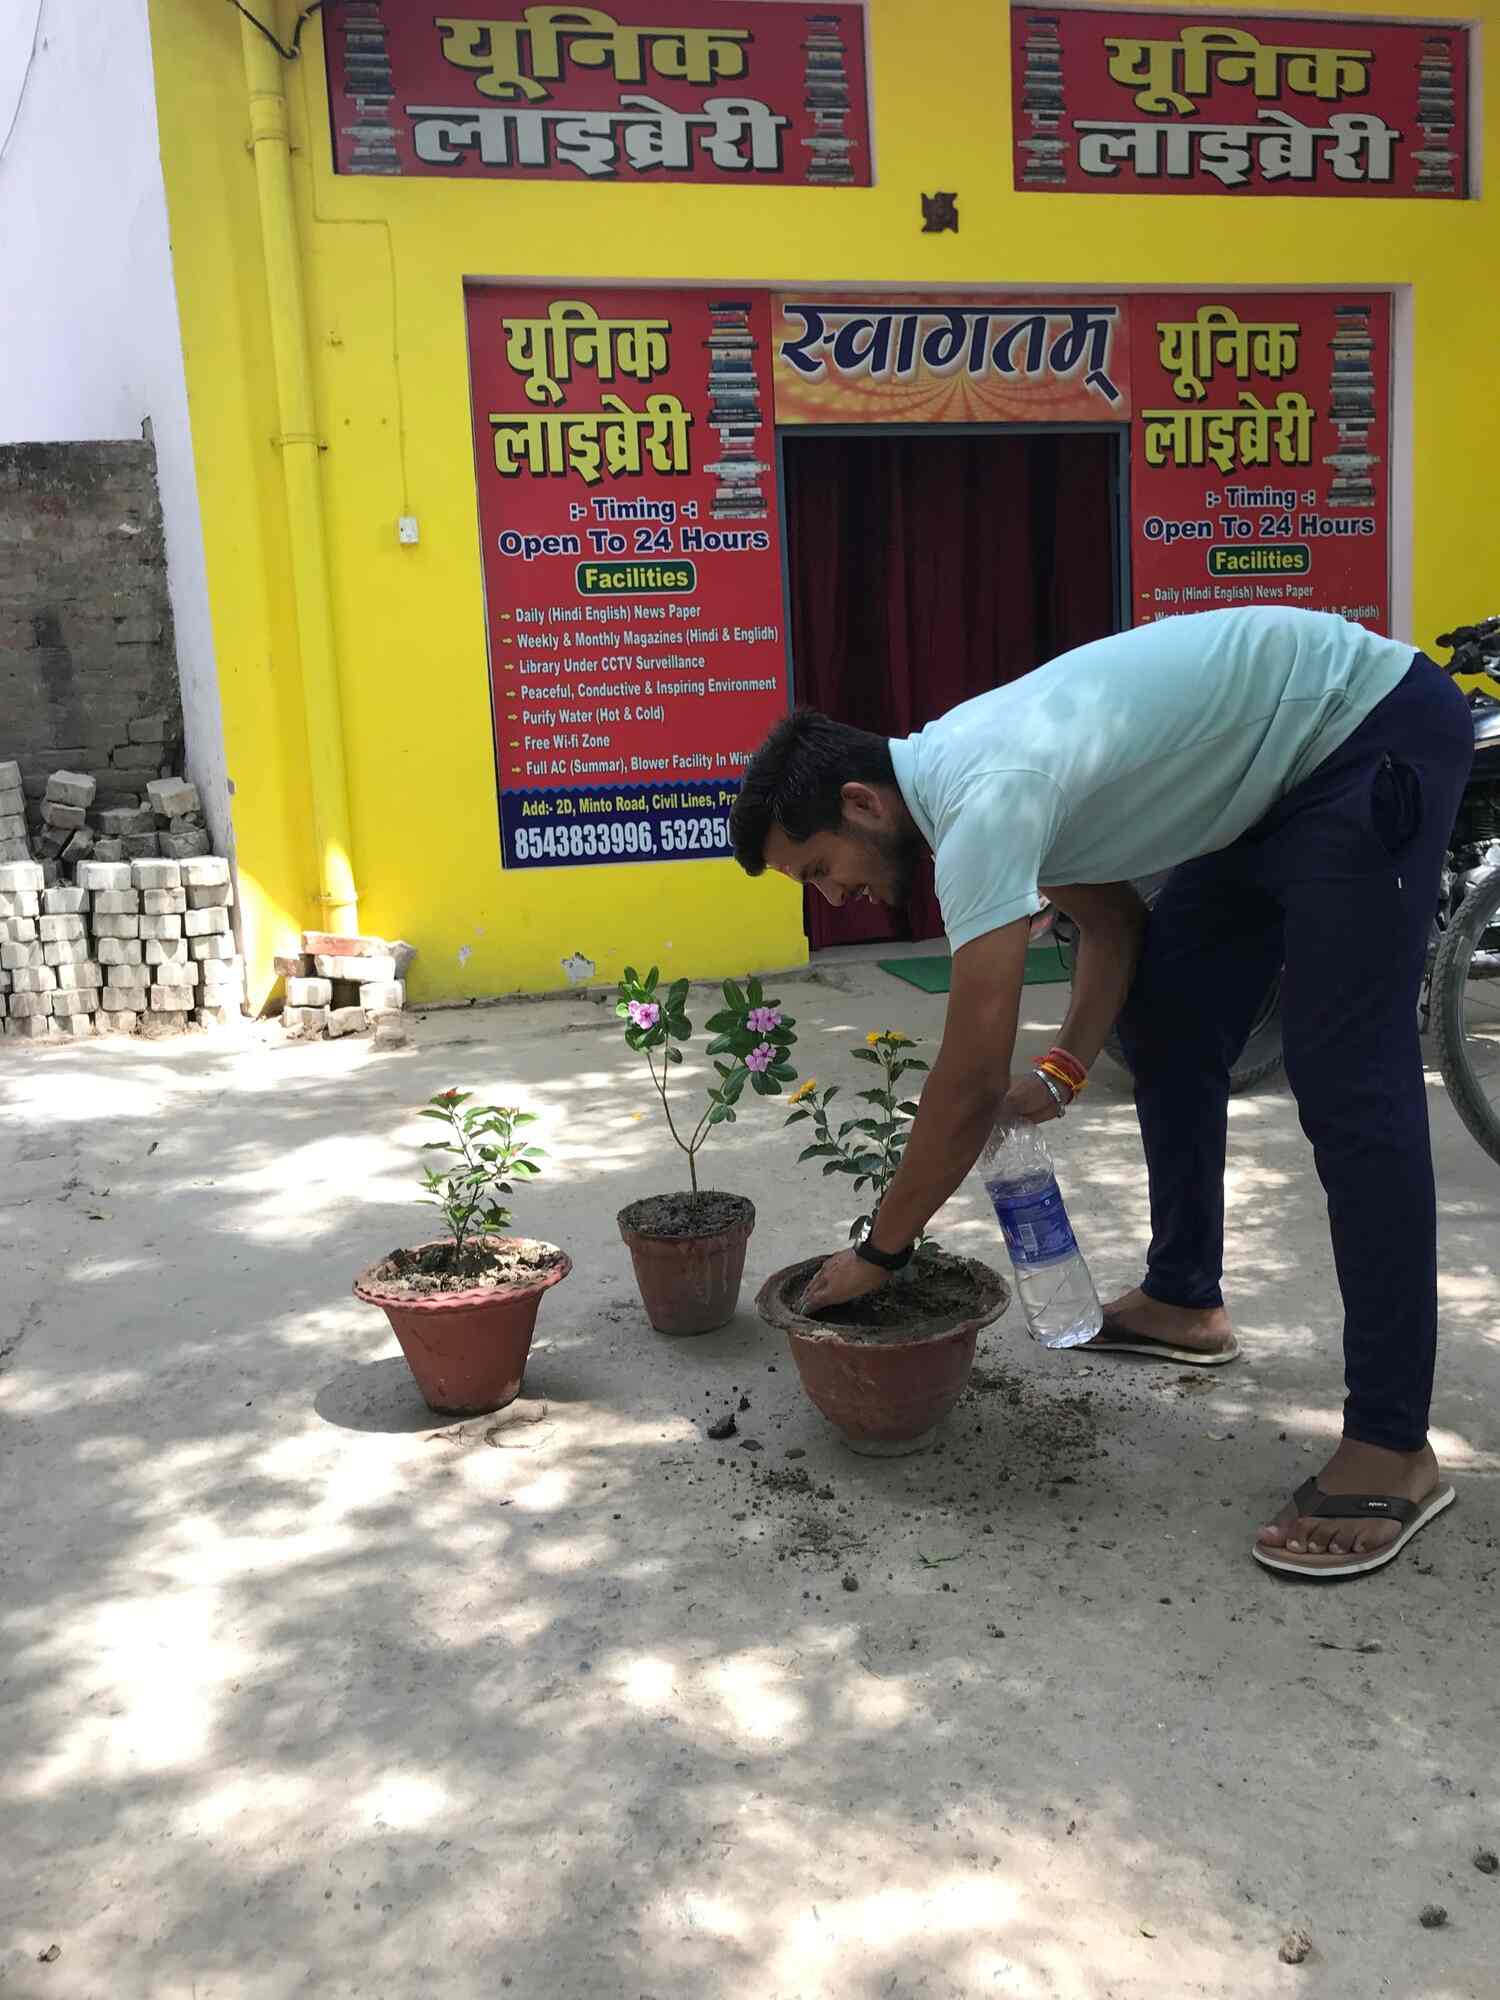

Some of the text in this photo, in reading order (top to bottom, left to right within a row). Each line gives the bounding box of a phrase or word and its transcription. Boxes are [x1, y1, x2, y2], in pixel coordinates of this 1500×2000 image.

[434, 2, 755, 101] यूनिक
[1103, 26, 1375, 118] यूनिक
[405, 95, 792, 179] लाइब्रेरी
[1073, 109, 1404, 188] लाइब्रेरी
[502, 300, 672, 406] यूनिक
[780, 304, 1121, 405] स्वागतम्
[1156, 304, 1300, 402] यूनिक
[489, 394, 695, 487] लाइब्रेरी
[1142, 392, 1317, 477] लाइब्रेरी
[591, 497, 676, 524] Timing
[1225, 485, 1297, 511] Timing
[1144, 514, 1374, 544] Open To 24 Hours
[498, 527, 769, 561] Open To 24 Hours
[1215, 549, 1305, 571] Facilities
[585, 567, 690, 589] Facilities
[1154, 584, 1314, 605] Daily (Hindi English) News Paper
[516, 603, 701, 625] Daily (Hindi English) News Paper
[517, 632, 559, 651] Weekly
[563, 632, 572, 647] &
[575, 630, 620, 648] Monthly
[623, 630, 682, 648] Magazines
[686, 627, 718, 646] (Hindi
[722, 627, 730, 641] &
[520, 655, 705, 676] Library Under CCTV Surveillance
[521, 676, 776, 700] Peaceful, Conductive & Inspiring Environment
[523, 705, 665, 727] Purify Water (Hot & Cold)
[525, 735, 550, 750] Free
[582, 733, 610, 748] Zone
[526, 751, 753, 776] Full AC (Summar), Blower Facility In Win
[556, 798, 576, 816] 2D,
[579, 797, 612, 813] Minto
[616, 795, 649, 813] Road,
[652, 793, 678, 810] Civil
[681, 792, 716, 809] Lines,
[719, 791, 738, 806] Pra
[514, 817, 734, 860] 8543833996, 53235
